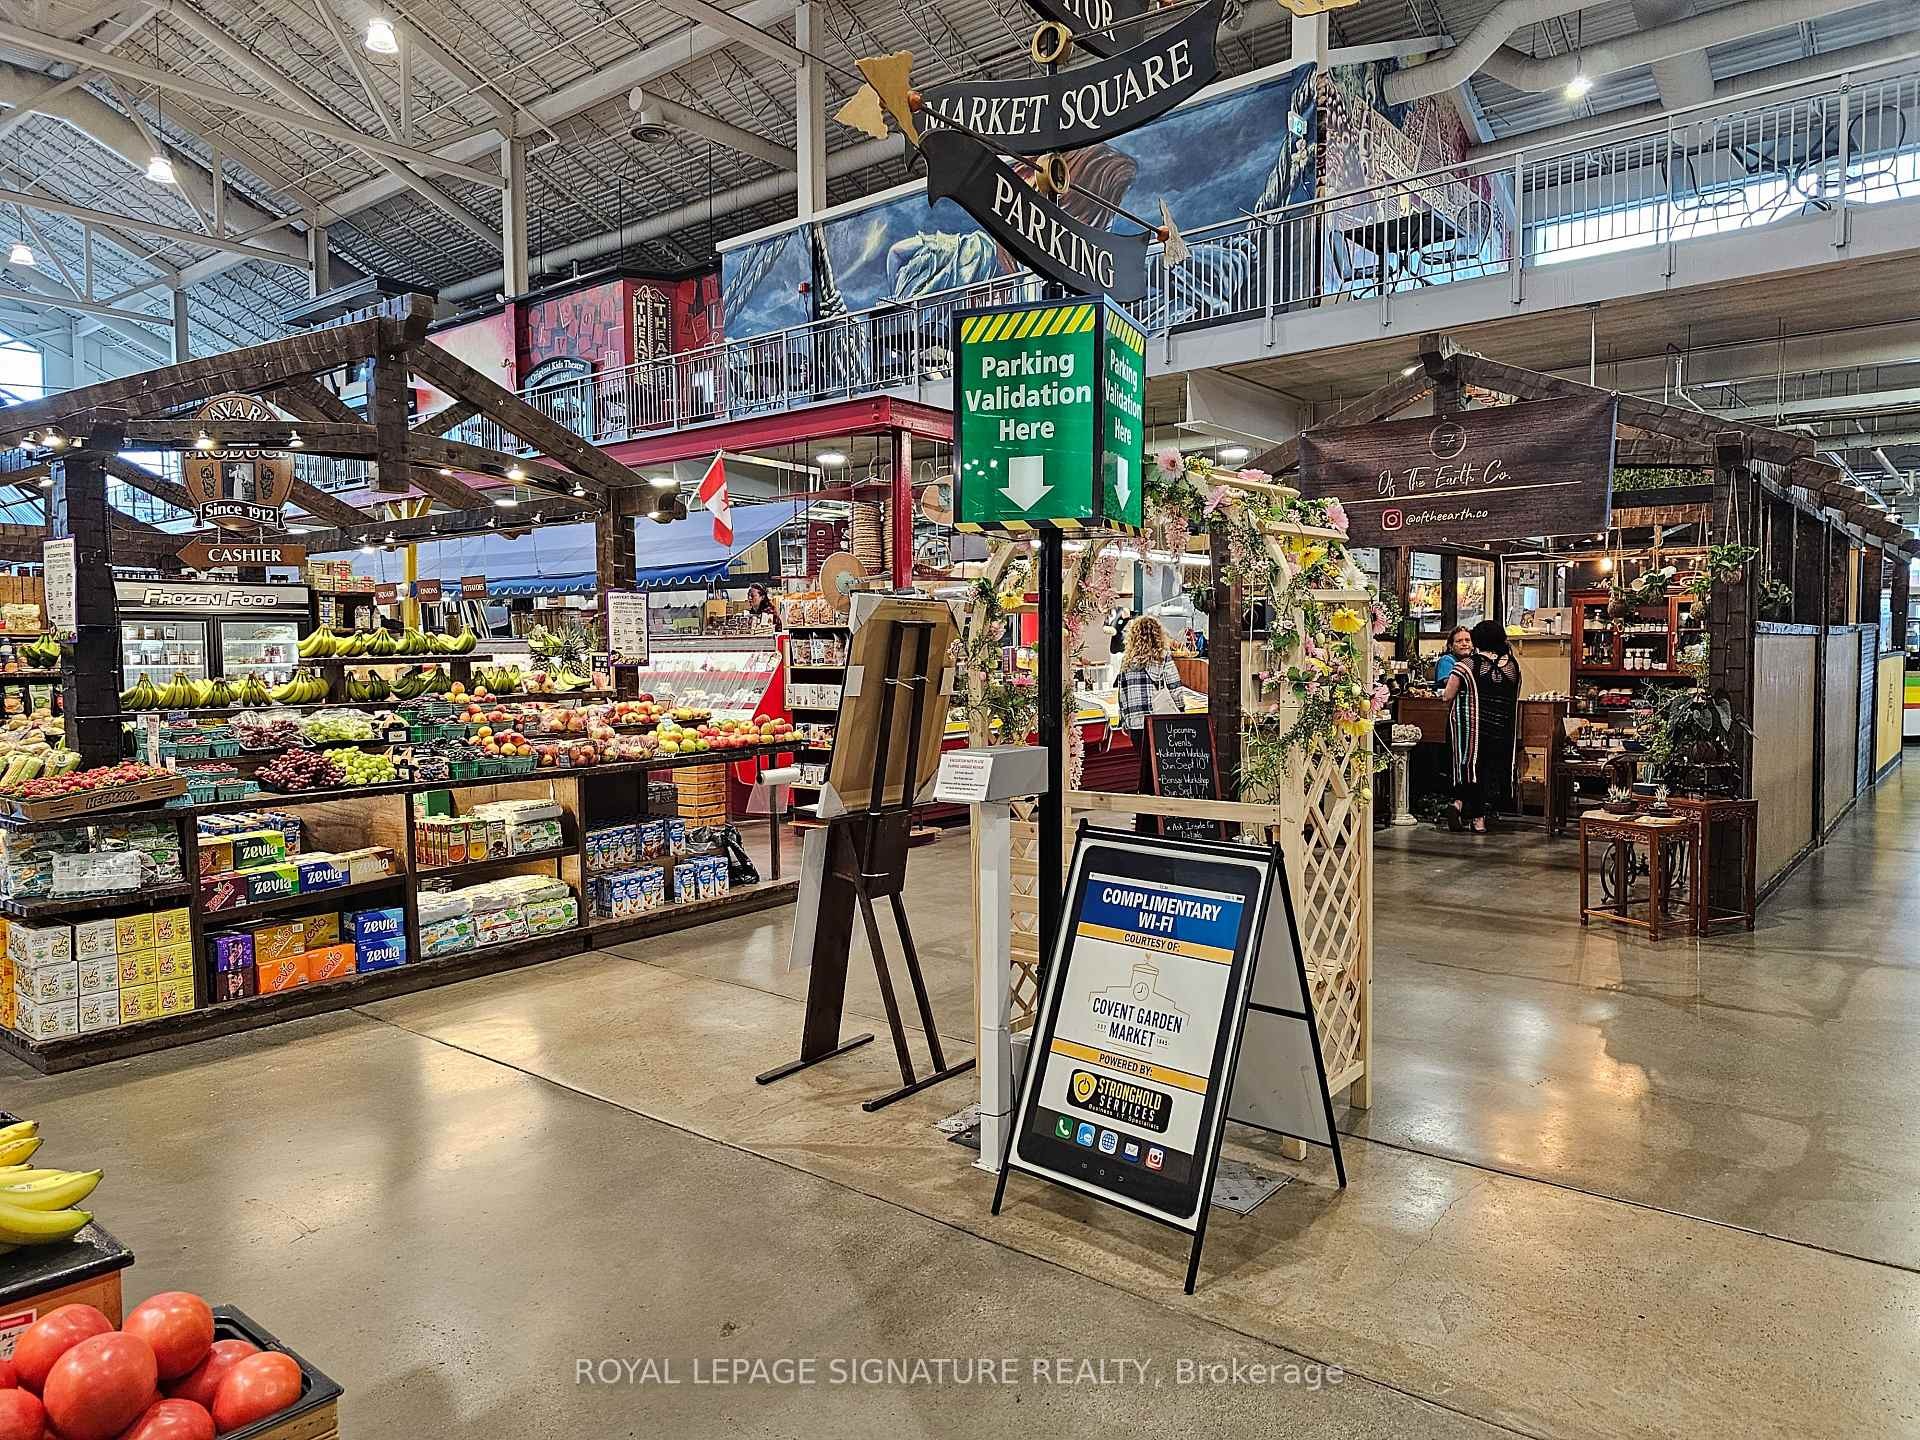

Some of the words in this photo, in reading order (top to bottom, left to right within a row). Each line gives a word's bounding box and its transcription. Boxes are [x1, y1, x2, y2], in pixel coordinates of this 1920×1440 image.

[924, 94, 1049, 135] MARKET
[1058, 39, 1195, 130] SQUARE
[991, 172, 1116, 289] PARKING
[982, 350, 1075, 379] Parking
[1110, 348, 1138, 393] Parking
[965, 384, 1091, 412] Validation
[1105, 377, 1142, 422] Validation
[999, 419, 1055, 442] Here
[1114, 416, 1131, 445] Here
[1378, 469, 1396, 498] Of
[1402, 466, 1431, 491] The
[1434, 462, 1480, 489] Earth
[1483, 459, 1511, 484] Co.
[205, 503, 242, 516] Since
[246, 506, 274, 522] 1912
[1405, 507, 1489, 526] @oftheearth.co
[208, 548, 282, 562] CASHIER
[144, 589, 220, 606] FROZEN
[226, 591, 278, 607] FOOD
[1102, 887, 1222, 922] COMPLIMENTARY
[363, 918, 398, 934] zevia
[1138, 911, 1174, 933] WI-FI
[366, 945, 400, 963] zevia
[1124, 933, 1167, 950] COURTESY
[1167, 940, 1181, 952] OF:
[1092, 997, 1135, 1021] COVENT
[1136, 1008, 1183, 1033] GARDEN
[1108, 1021, 1156, 1047] MARKET
[1099, 1053, 1138, 1072] POWERED
[1140, 1064, 1153, 1077] BY:
[1097, 1078, 1162, 1111] STRONGHOLD
[1099, 1095, 1155, 1122] SERVICES
